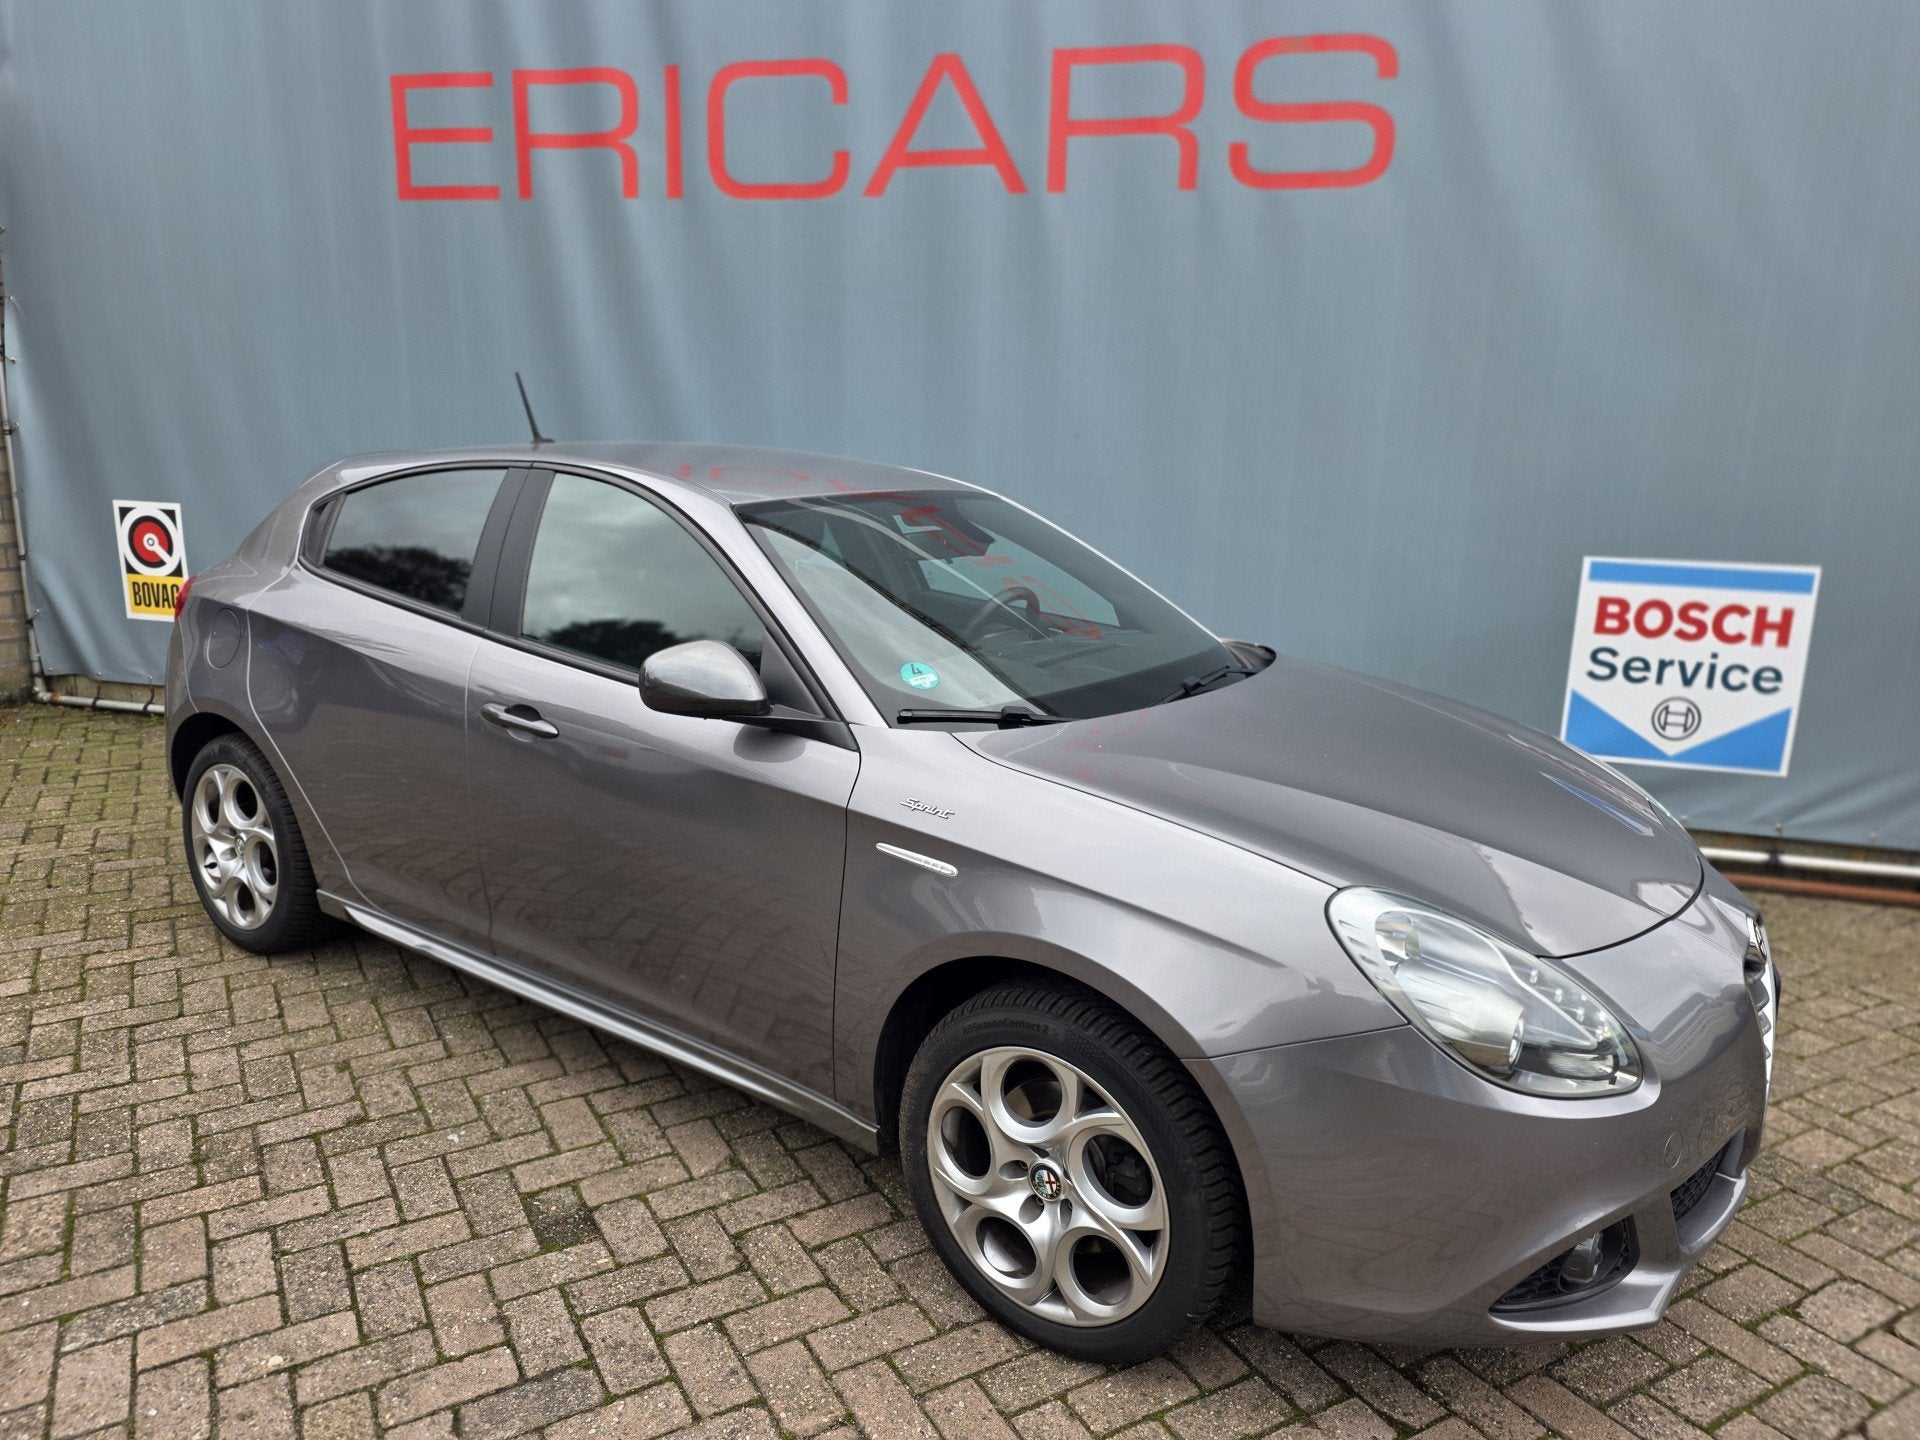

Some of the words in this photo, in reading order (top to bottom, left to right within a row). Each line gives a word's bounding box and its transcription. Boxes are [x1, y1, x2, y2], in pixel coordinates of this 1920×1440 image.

[389, 33, 1399, 202] ERICARS
[1593, 596, 1795, 648] BOSCH
[910, 663, 923, 675] 4
[1586, 646, 1784, 695] Service
[899, 797, 955, 819] Sprint
